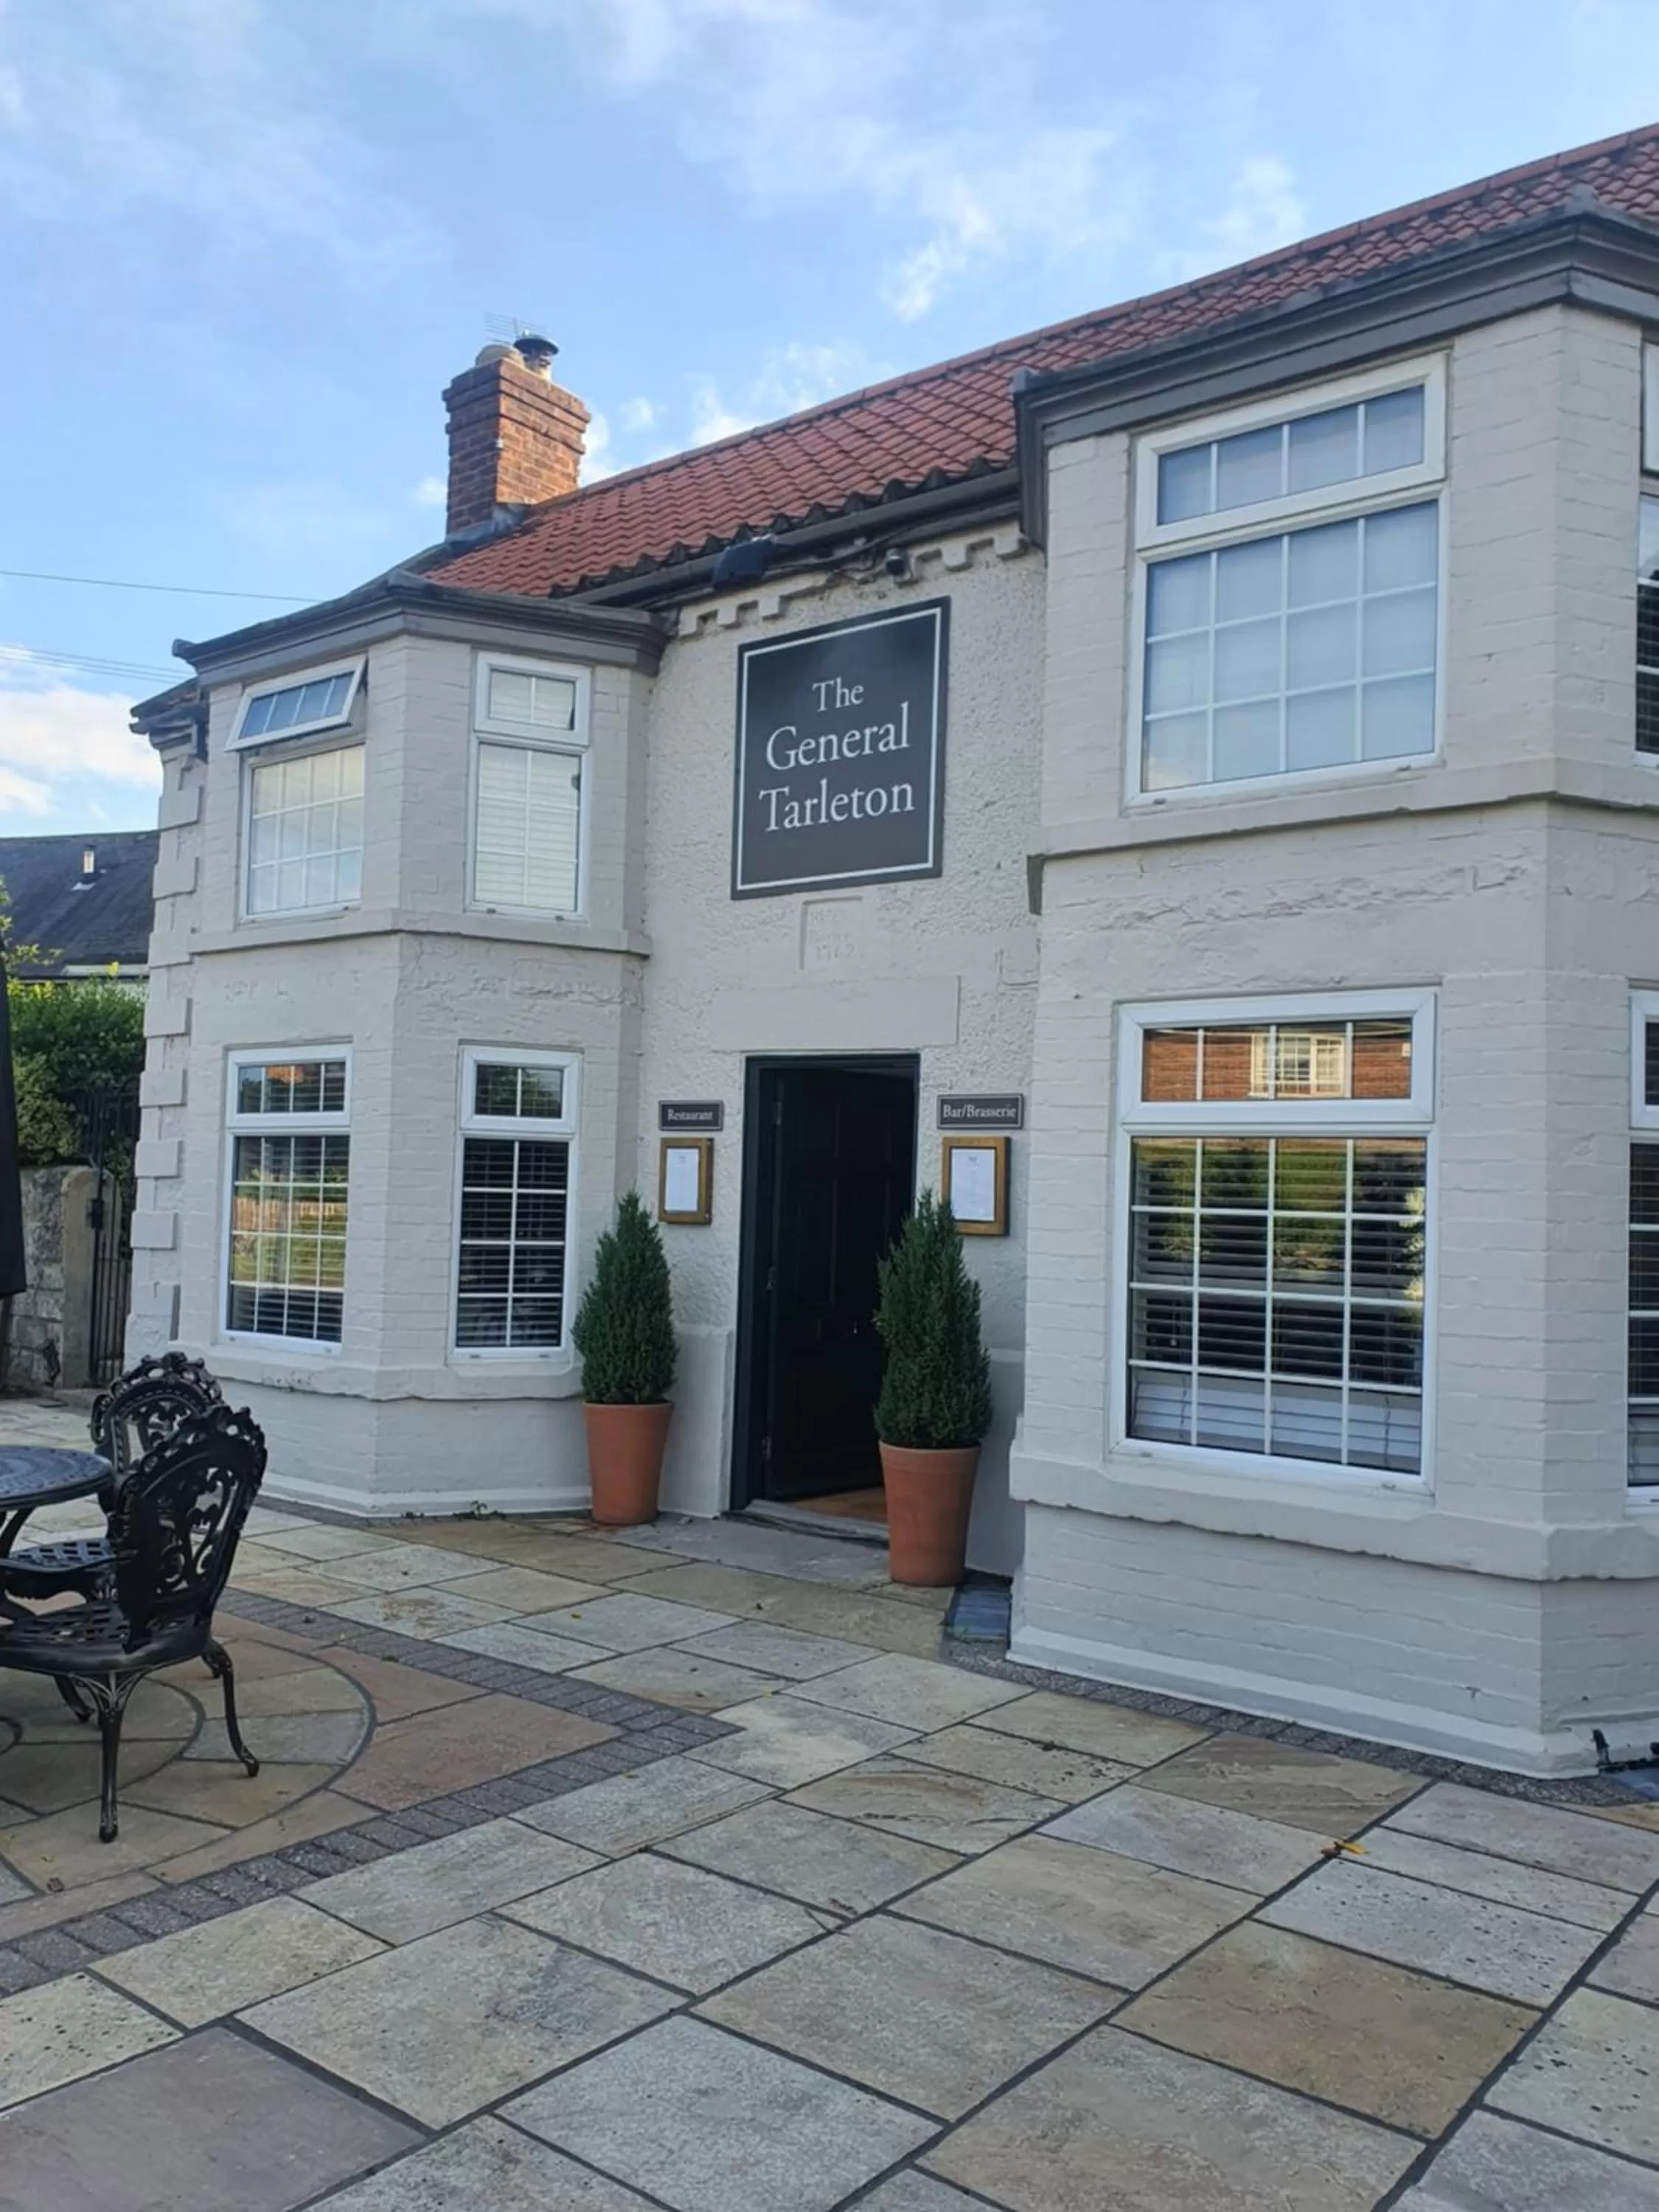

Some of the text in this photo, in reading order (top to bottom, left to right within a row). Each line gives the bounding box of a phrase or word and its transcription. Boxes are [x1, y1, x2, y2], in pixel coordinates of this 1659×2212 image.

[812, 676, 865, 713] The
[765, 700, 911, 771] General
[758, 777, 915, 832] Tarleton
[667, 1108, 714, 1121] Restaurant
[942, 1103, 1017, 1119] Bar/Brasserie
